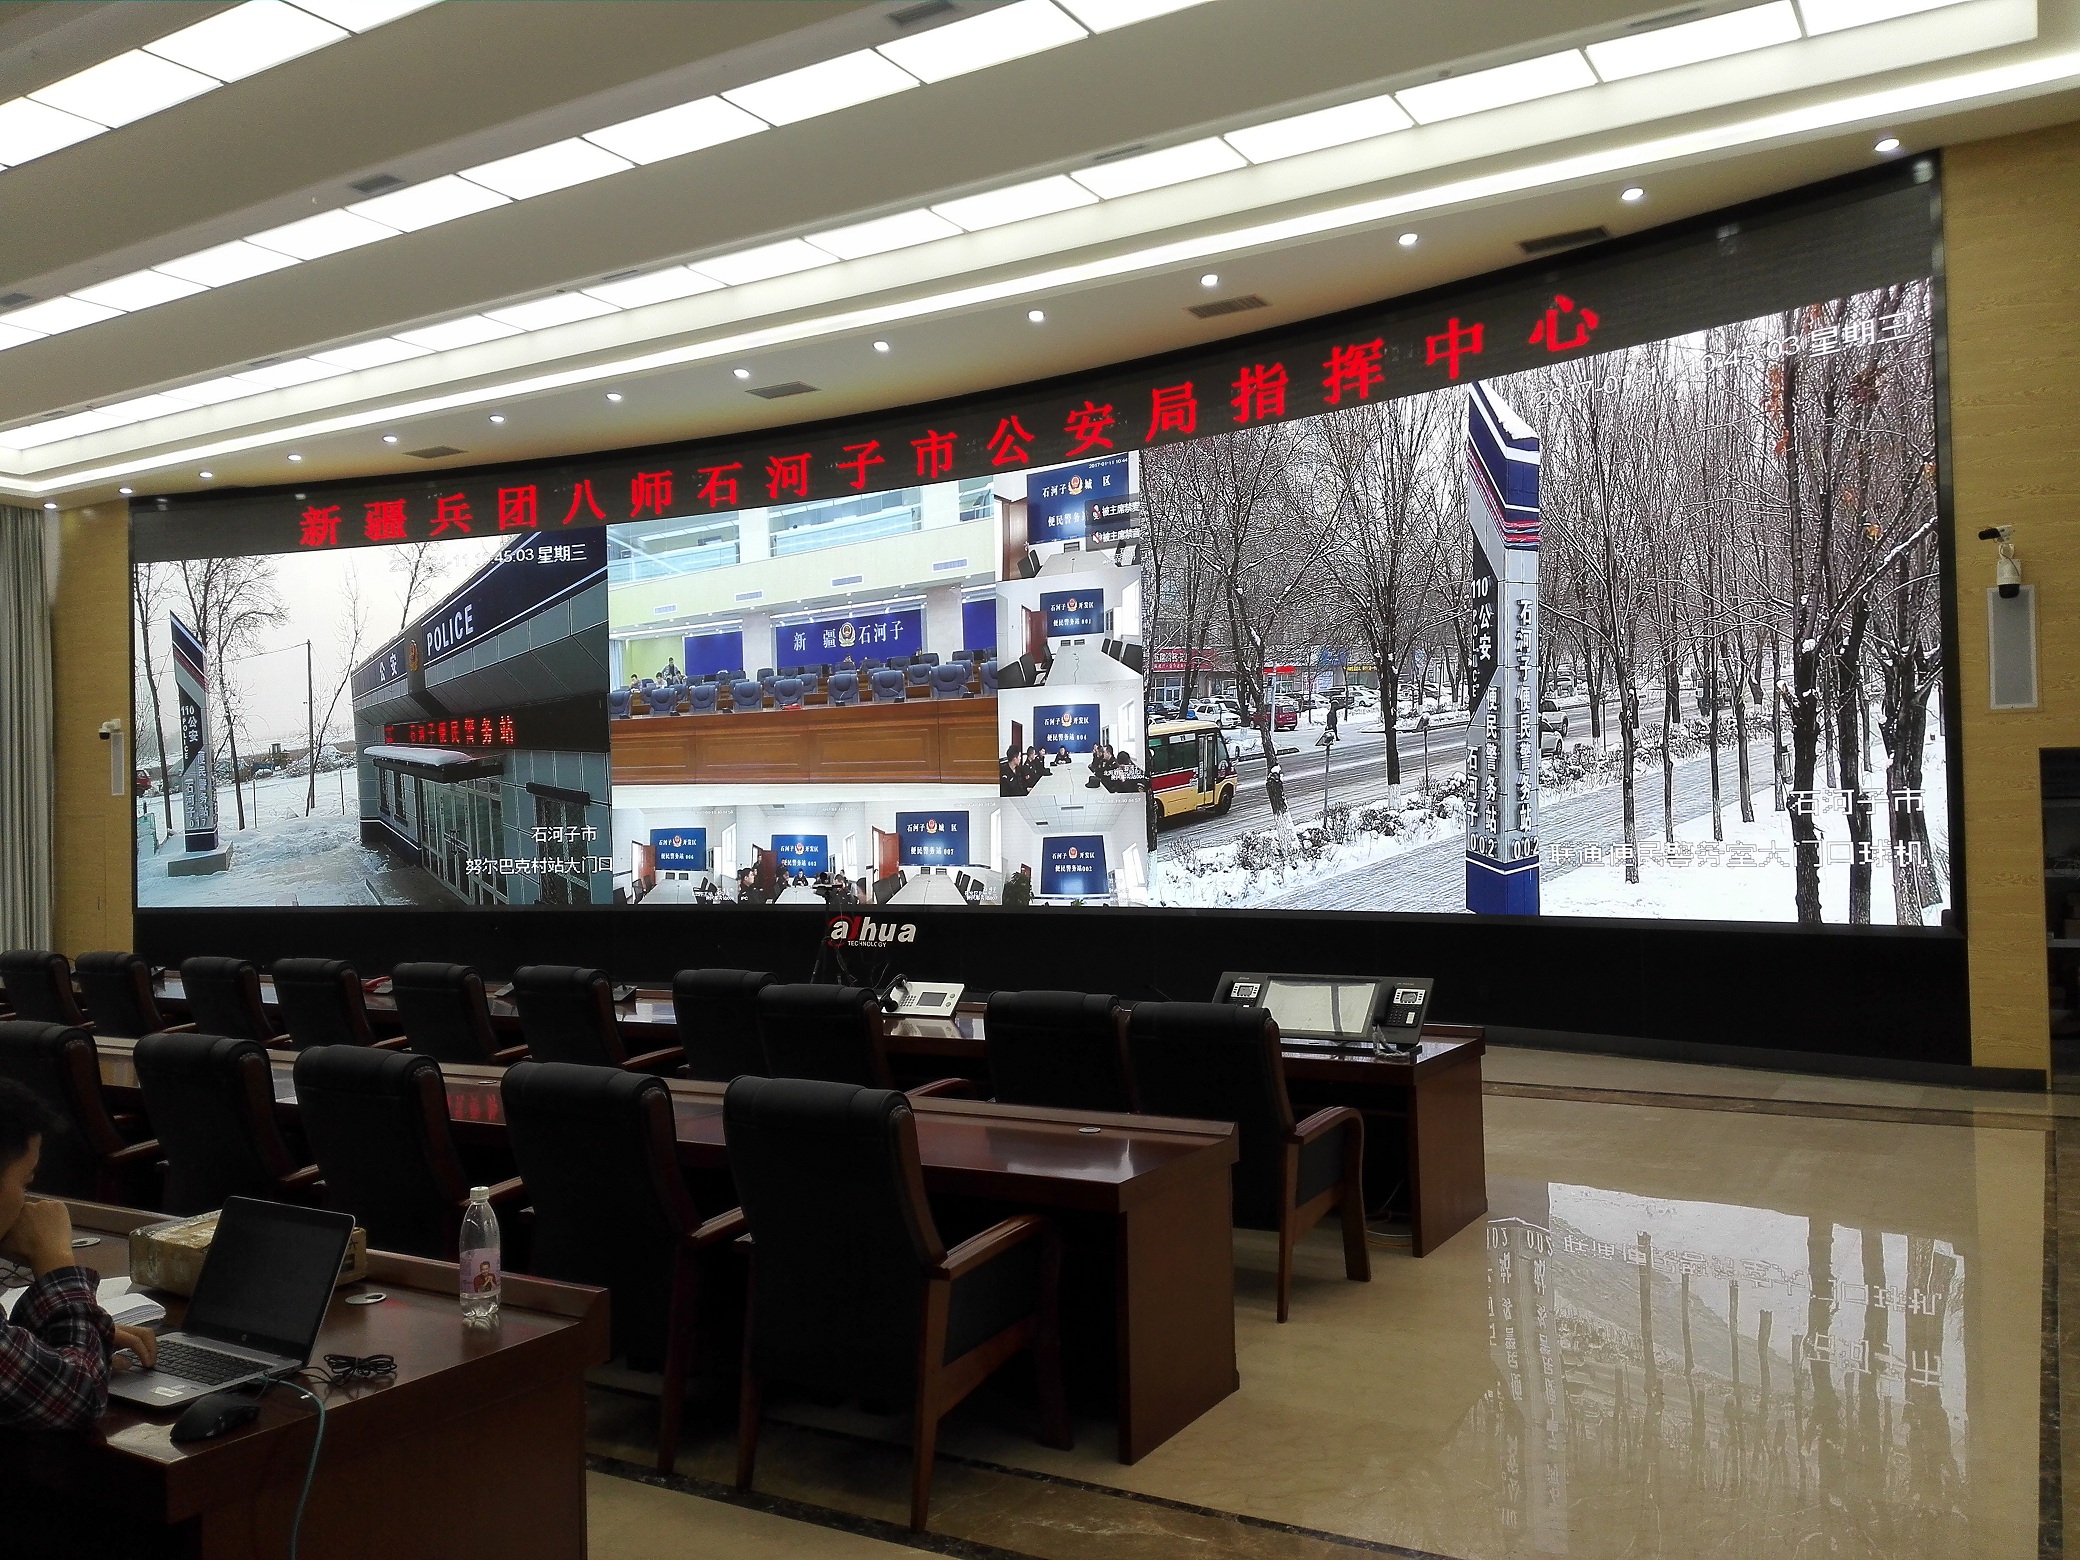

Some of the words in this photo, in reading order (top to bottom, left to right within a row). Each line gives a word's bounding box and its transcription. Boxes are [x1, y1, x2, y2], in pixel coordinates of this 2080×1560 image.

[1534, 365, 1671, 409] 2017-01-11
[1685, 335, 1799, 376] 10:45:03
[1809, 312, 1910, 358] 星期三
[299, 294, 1600, 546] 新疆兵团八师石河子市公安局指挥中心
[537, 544, 588, 564] 星期三
[1471, 576, 1489, 599] 110
[426, 604, 475, 656] POLICE
[858, 620, 904, 645] 石河子
[1478, 604, 1493, 661] 公安
[379, 652, 398, 682] 公安
[1471, 609, 1480, 698] POLICE
[181, 705, 195, 716] 110
[182, 717, 190, 760] POLICE
[188, 716, 199, 742] 公安
[1485, 685, 1498, 835] 便民警务站
[184, 779, 196, 818] 石河子
[1466, 746, 1479, 828] 石河子
[1791, 787, 1926, 816] 石河子市
[531, 825, 598, 843] 石河子市
[1470, 833, 1496, 858] 002
[1511, 836, 1540, 860] 002
[465, 856, 613, 875] 努尔巴克村站大门口
[1548, 840, 1928, 868] 联通便民警务室大门口球机
